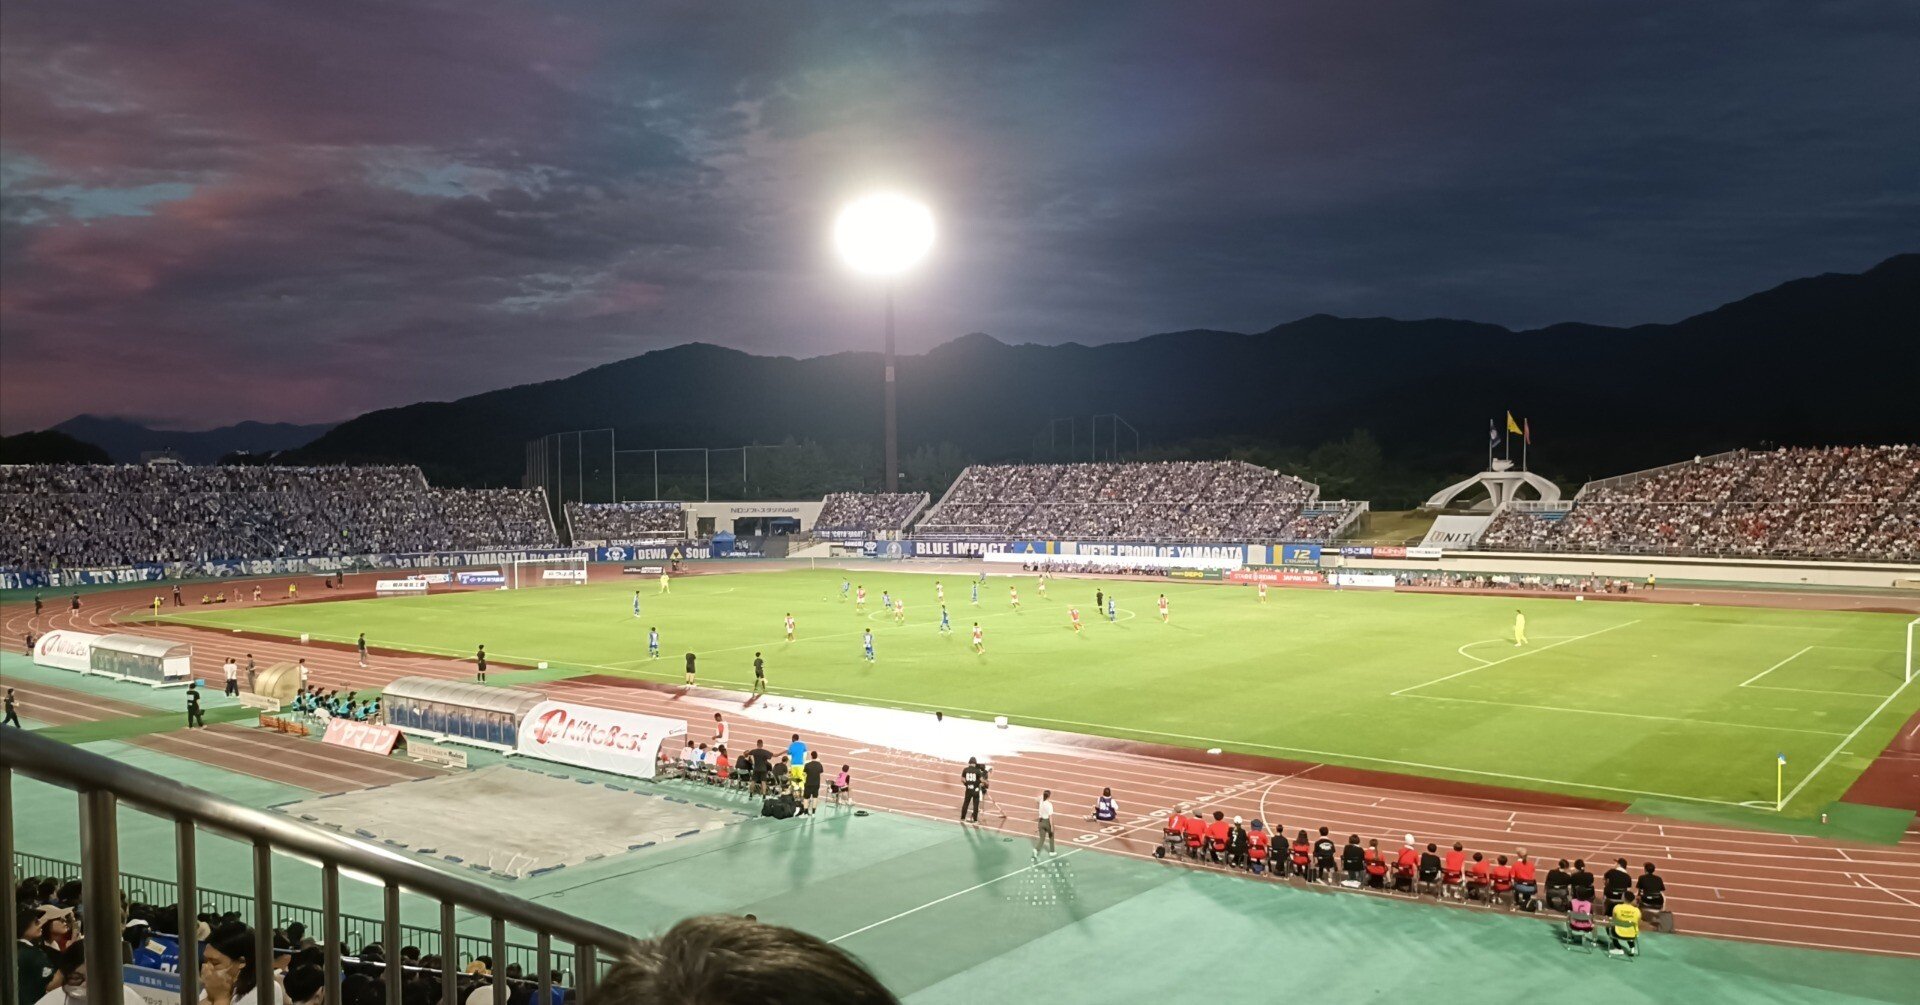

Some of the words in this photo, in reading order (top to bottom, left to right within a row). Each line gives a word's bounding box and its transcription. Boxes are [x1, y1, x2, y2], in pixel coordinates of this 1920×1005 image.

[638, 548, 668, 560] DEWA
[686, 547, 711, 559] SOUL
[916, 542, 949, 555] BLUE
[952, 542, 1008, 555] IMPACT
[1117, 545, 1157, 558] PROUD
[1159, 546, 1175, 558] OF
[1177, 546, 1243, 560] YAMAGATA
[1293, 549, 1311, 559] 12
[464, 552, 527, 566] YAMAGATA
[341, 724, 393, 752] ヤマコン
